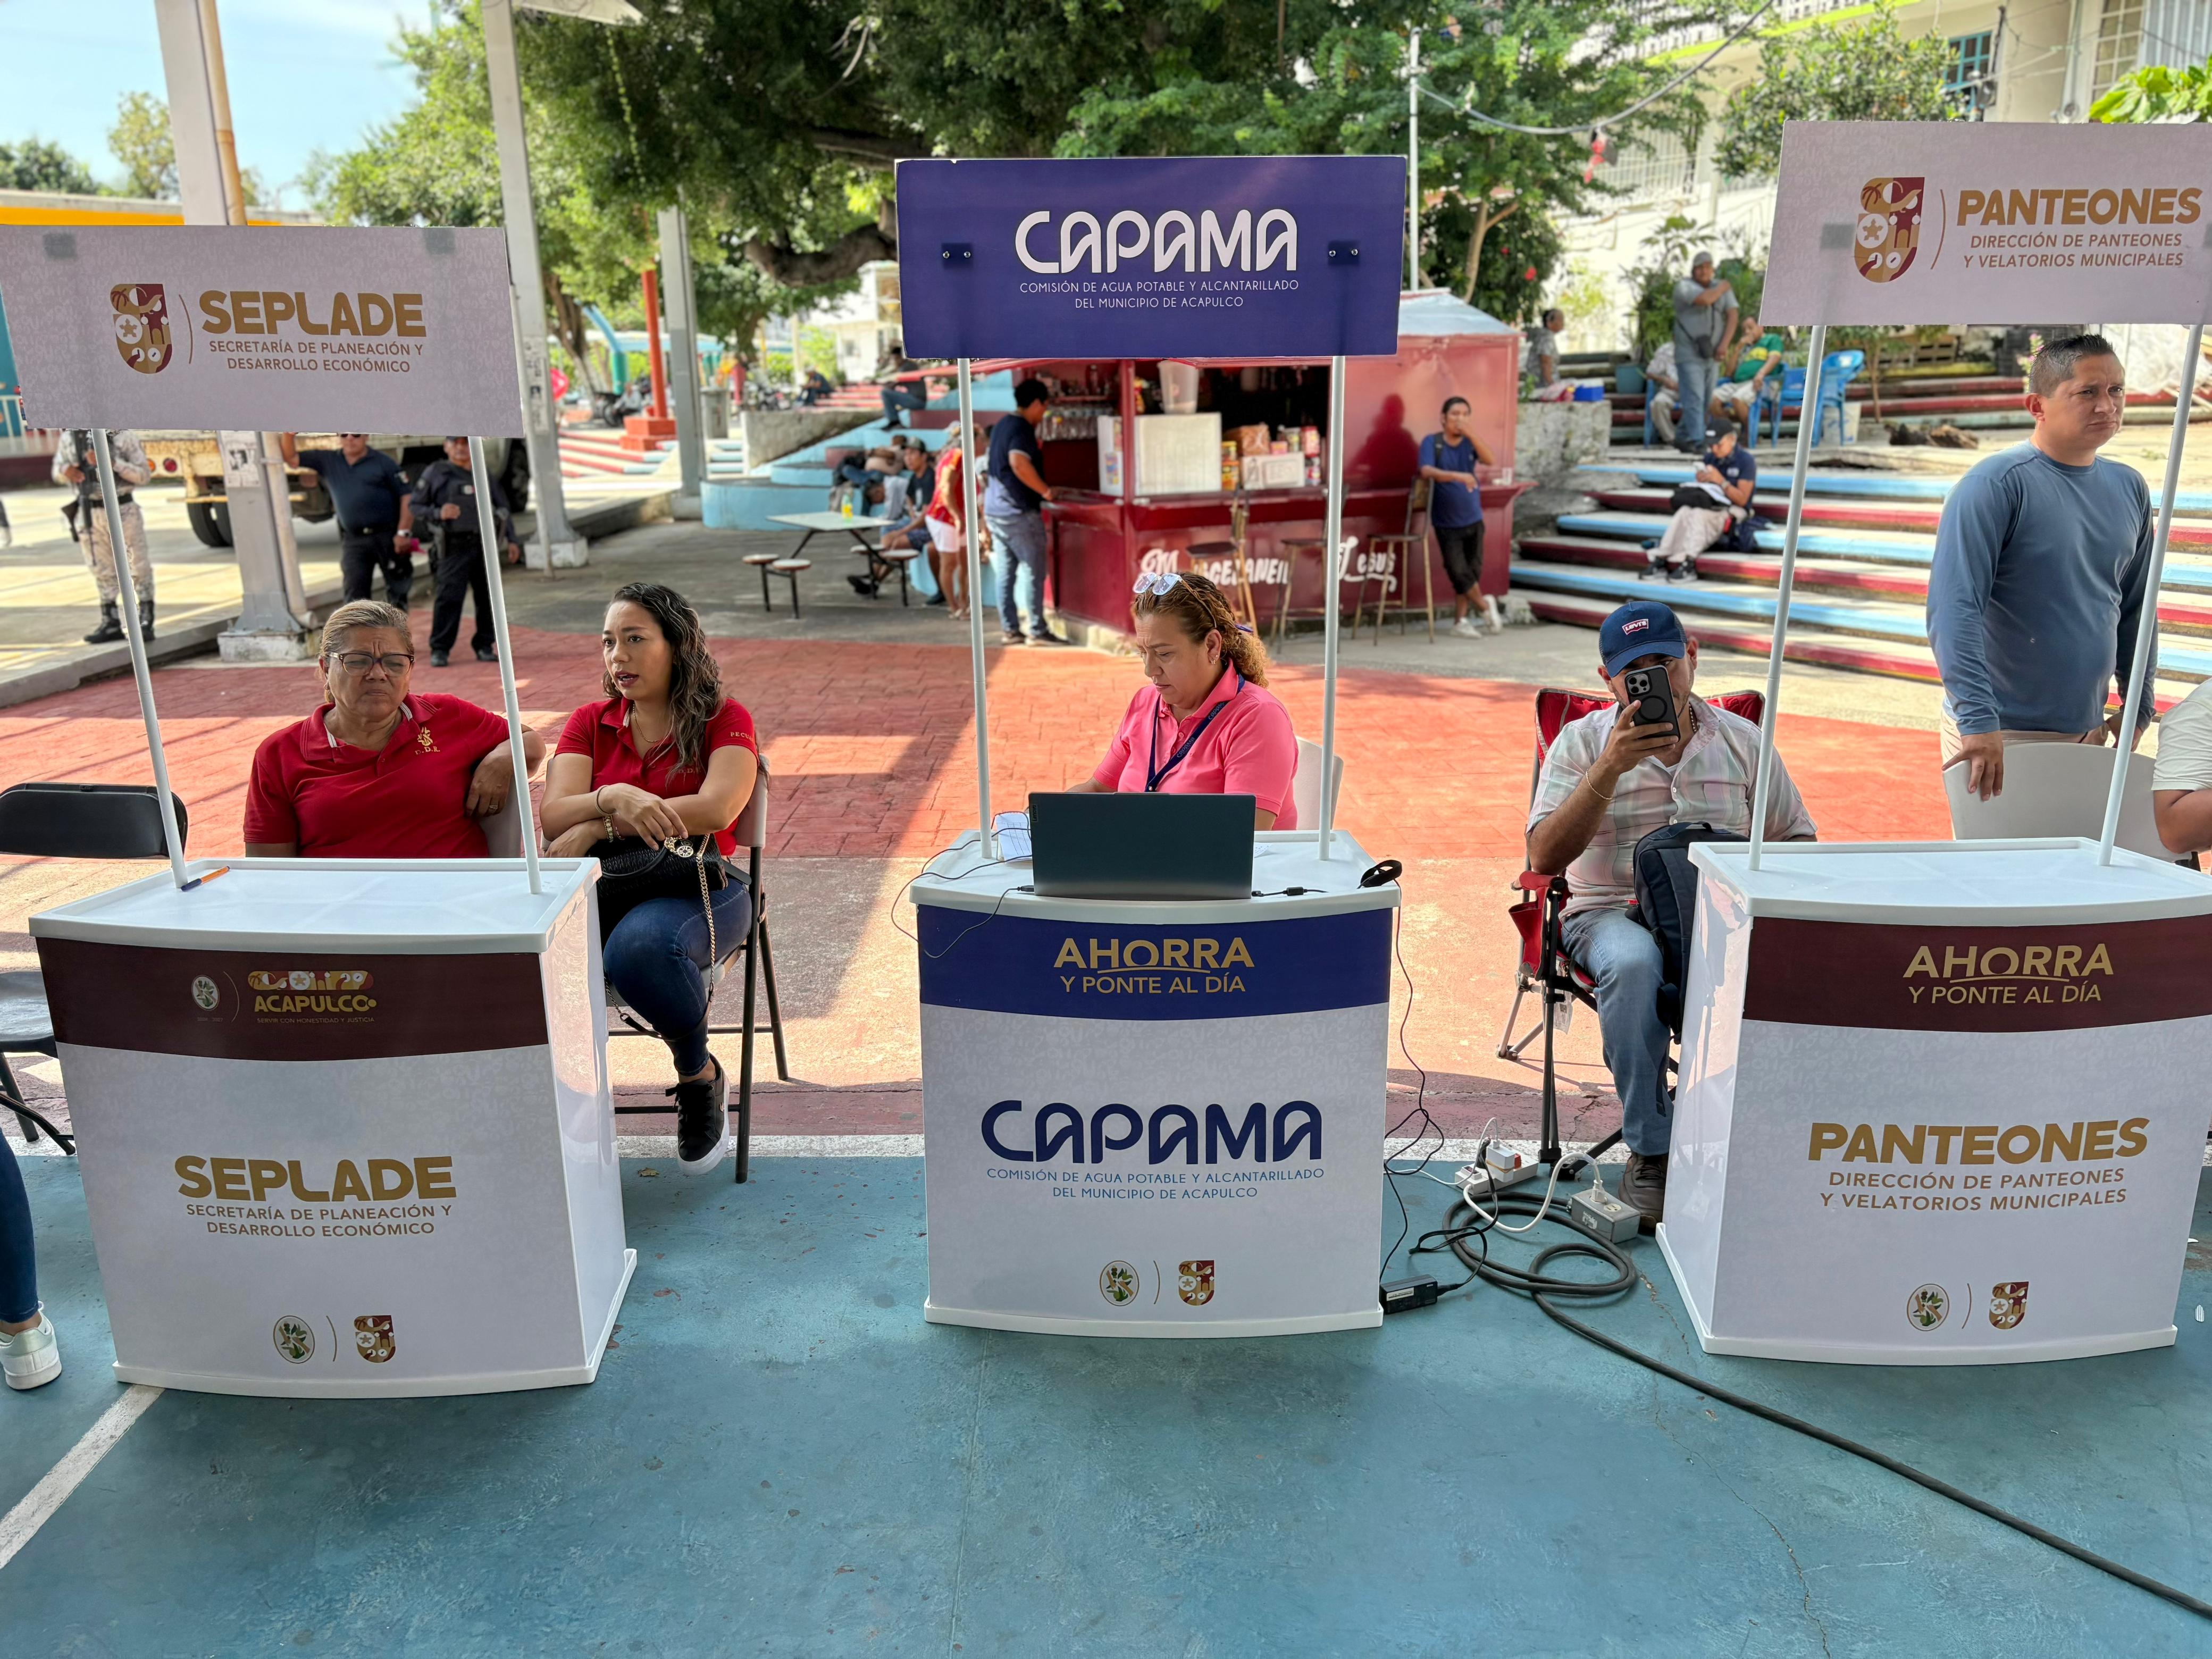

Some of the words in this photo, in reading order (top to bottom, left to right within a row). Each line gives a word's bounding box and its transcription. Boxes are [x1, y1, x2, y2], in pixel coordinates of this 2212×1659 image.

[1957, 188, 2202, 225] PANTEONES
[1015, 209, 1297, 273] CAPAMA
[1971, 232, 2057, 248] DIRECCIÓN
[2063, 234, 2083, 247] DE
[2089, 233, 2182, 247] PANTEONES
[1964, 255, 1973, 268] Y
[1979, 254, 2075, 267] VELATORIOS
[2081, 253, 2183, 266] MUNICIPALES
[1020, 281, 1078, 292] COMISIÓN
[1084, 282, 1096, 292] DE
[1102, 282, 1132, 291] AGUA
[1137, 282, 1184, 291] POTABLE
[1189, 281, 1196, 291] Y
[1201, 280, 1298, 290] ALCANTARILLADO
[1076, 299, 1094, 308] DEL
[1099, 298, 1158, 307] MUNICIPIO
[1163, 298, 1176, 307] DE
[1182, 297, 1243, 307] ACAPULCO
[199, 290, 426, 337] SEPLADE
[210, 339, 293, 353] SECRETARÍA
[298, 342, 316, 353] DE
[321, 341, 410, 355] PLANEACIÓN
[415, 345, 423, 355] Y
[228, 358, 317, 370] DESARROLLO
[323, 358, 409, 372] ECONÓMICO
[1208, 702, 1225, 720] CAPAM
[1054, 937, 1254, 969] AHORRA
[1903, 944, 2114, 979] AHORRA
[1060, 976, 1075, 992] Y
[1083, 977, 1161, 994] PONTE
[1169, 977, 1198, 993] AL
[1205, 973, 1245, 993] DÍA
[1909, 987, 1924, 1003] Y
[1932, 986, 2017, 1004] PONTE
[2024, 986, 2054, 1003] AL
[2062, 983, 2101, 1002] DÍA
[254, 995, 370, 1012] ACAPULCO
[982, 1100, 1321, 1164] CAPAMA
[1808, 1118, 2149, 1164] PANTEONES
[175, 1155, 456, 1202] SEPLADE
[987, 1169, 1057, 1181] COMISIÓN
[1063, 1172, 1078, 1182] DE
[1085, 1173, 1122, 1183] AGUA
[1128, 1174, 1185, 1183] POTABLE
[1192, 1174, 1200, 1183] Y
[1206, 1169, 1323, 1183] ALCANTARILLADO
[1830, 1172, 1954, 1189] DIRECCIÓN
[1964, 1176, 1992, 1189] DE
[2001, 1168, 2124, 1188] PANTEONES
[1053, 1187, 1076, 1197] DEL
[1082, 1188, 1154, 1199] MUNICIPIO
[1161, 1189, 1176, 1199] DE
[1182, 1188, 1257, 1199] ACAPULCO
[1821, 1193, 1833, 1206] Y
[1842, 1194, 1981, 1210] VELATORIOS
[1990, 1188, 2127, 1210] MUNICIPALES
[187, 1204, 285, 1219] SECRETARÍA
[291, 1209, 313, 1220] DE
[320, 1204, 434, 1220] PLANEACIÓN
[441, 1205, 451, 1216] Y
[207, 1222, 315, 1237] DESARROLLO
[322, 1222, 434, 1236] ECONÓMICO
